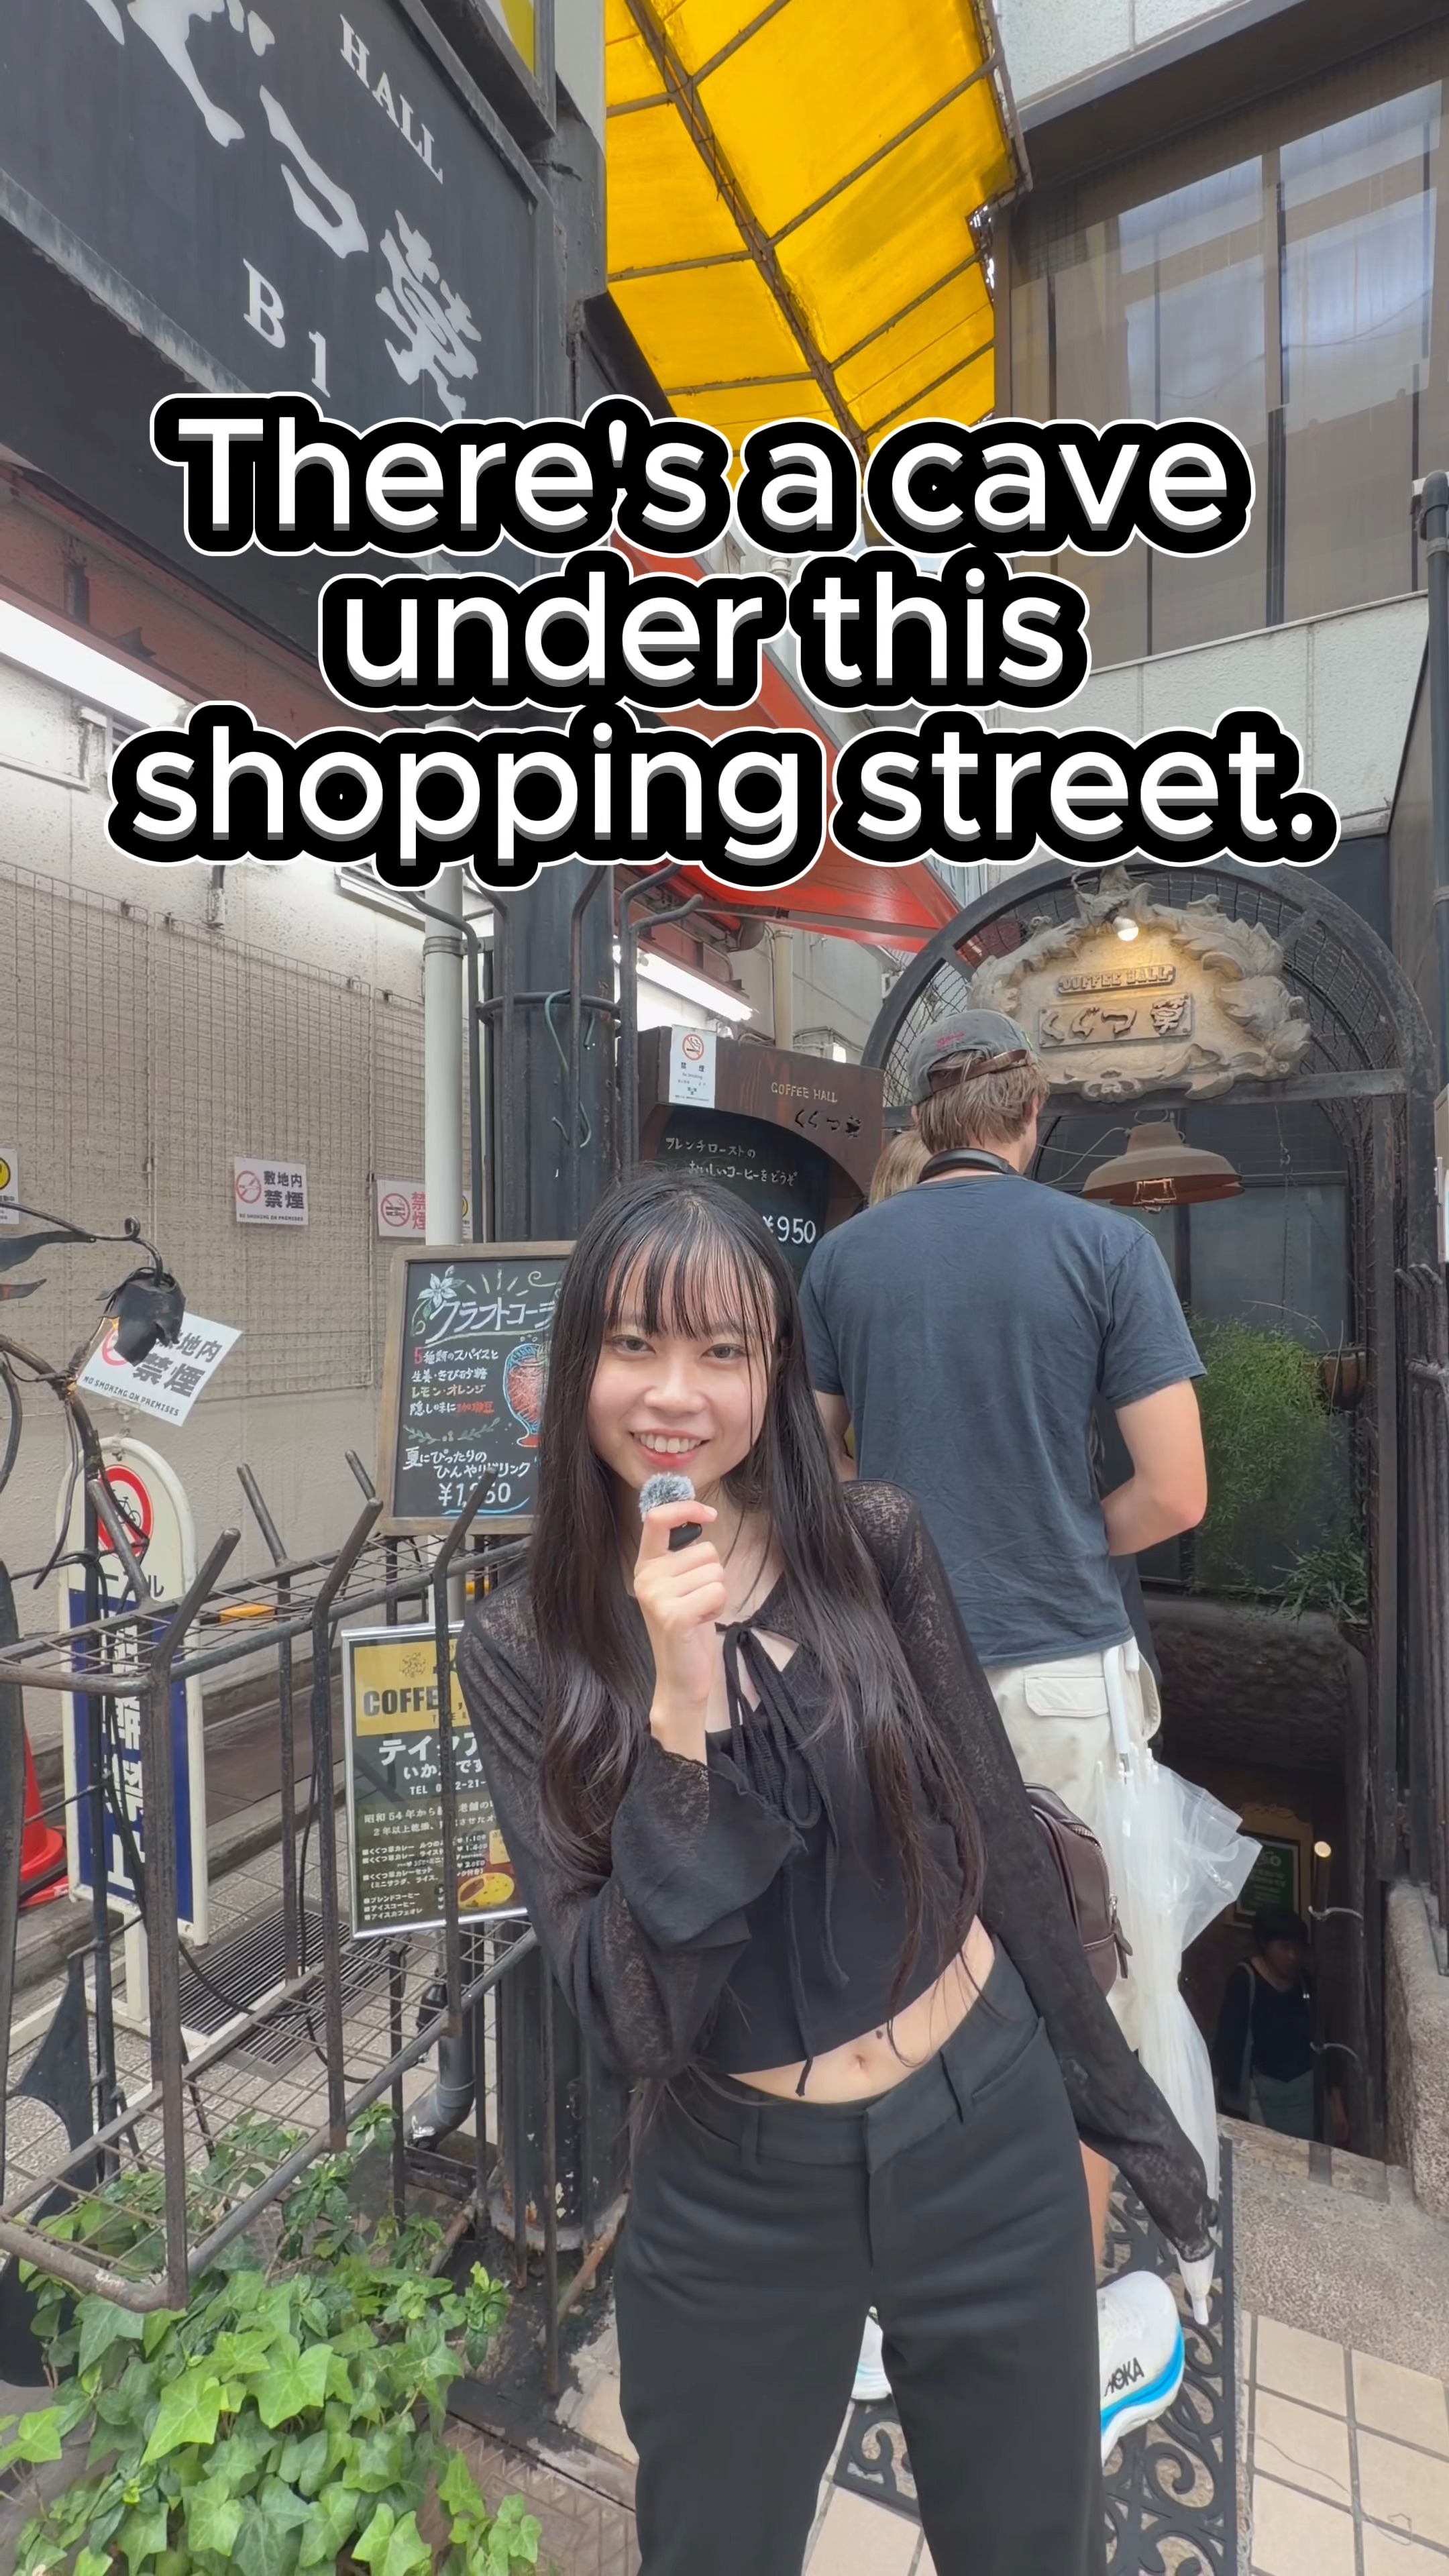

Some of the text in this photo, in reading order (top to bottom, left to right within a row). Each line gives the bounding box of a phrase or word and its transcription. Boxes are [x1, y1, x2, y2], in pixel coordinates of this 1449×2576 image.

[340, 13, 443, 184] HALL
[243, 258, 330, 397] B1
[1060, 965, 1173, 991] COFFEE HALL
[771, 1082, 838, 1103] COFFEE HALL
[665, 1138, 756, 1159] フレンチローストの
[264, 1171, 303, 1188] 敷地内
[264, 1190, 305, 1209] 禁煙
[133, 1352, 205, 1397] 禁煙
[83, 1375, 180, 1417] NO SMOKING ON PREMISES
[402, 1446, 488, 1470] 夏にぴったりの
[410, 1785, 428, 1795] TEL
[371, 1901, 416, 1912] アイスコーヒー
